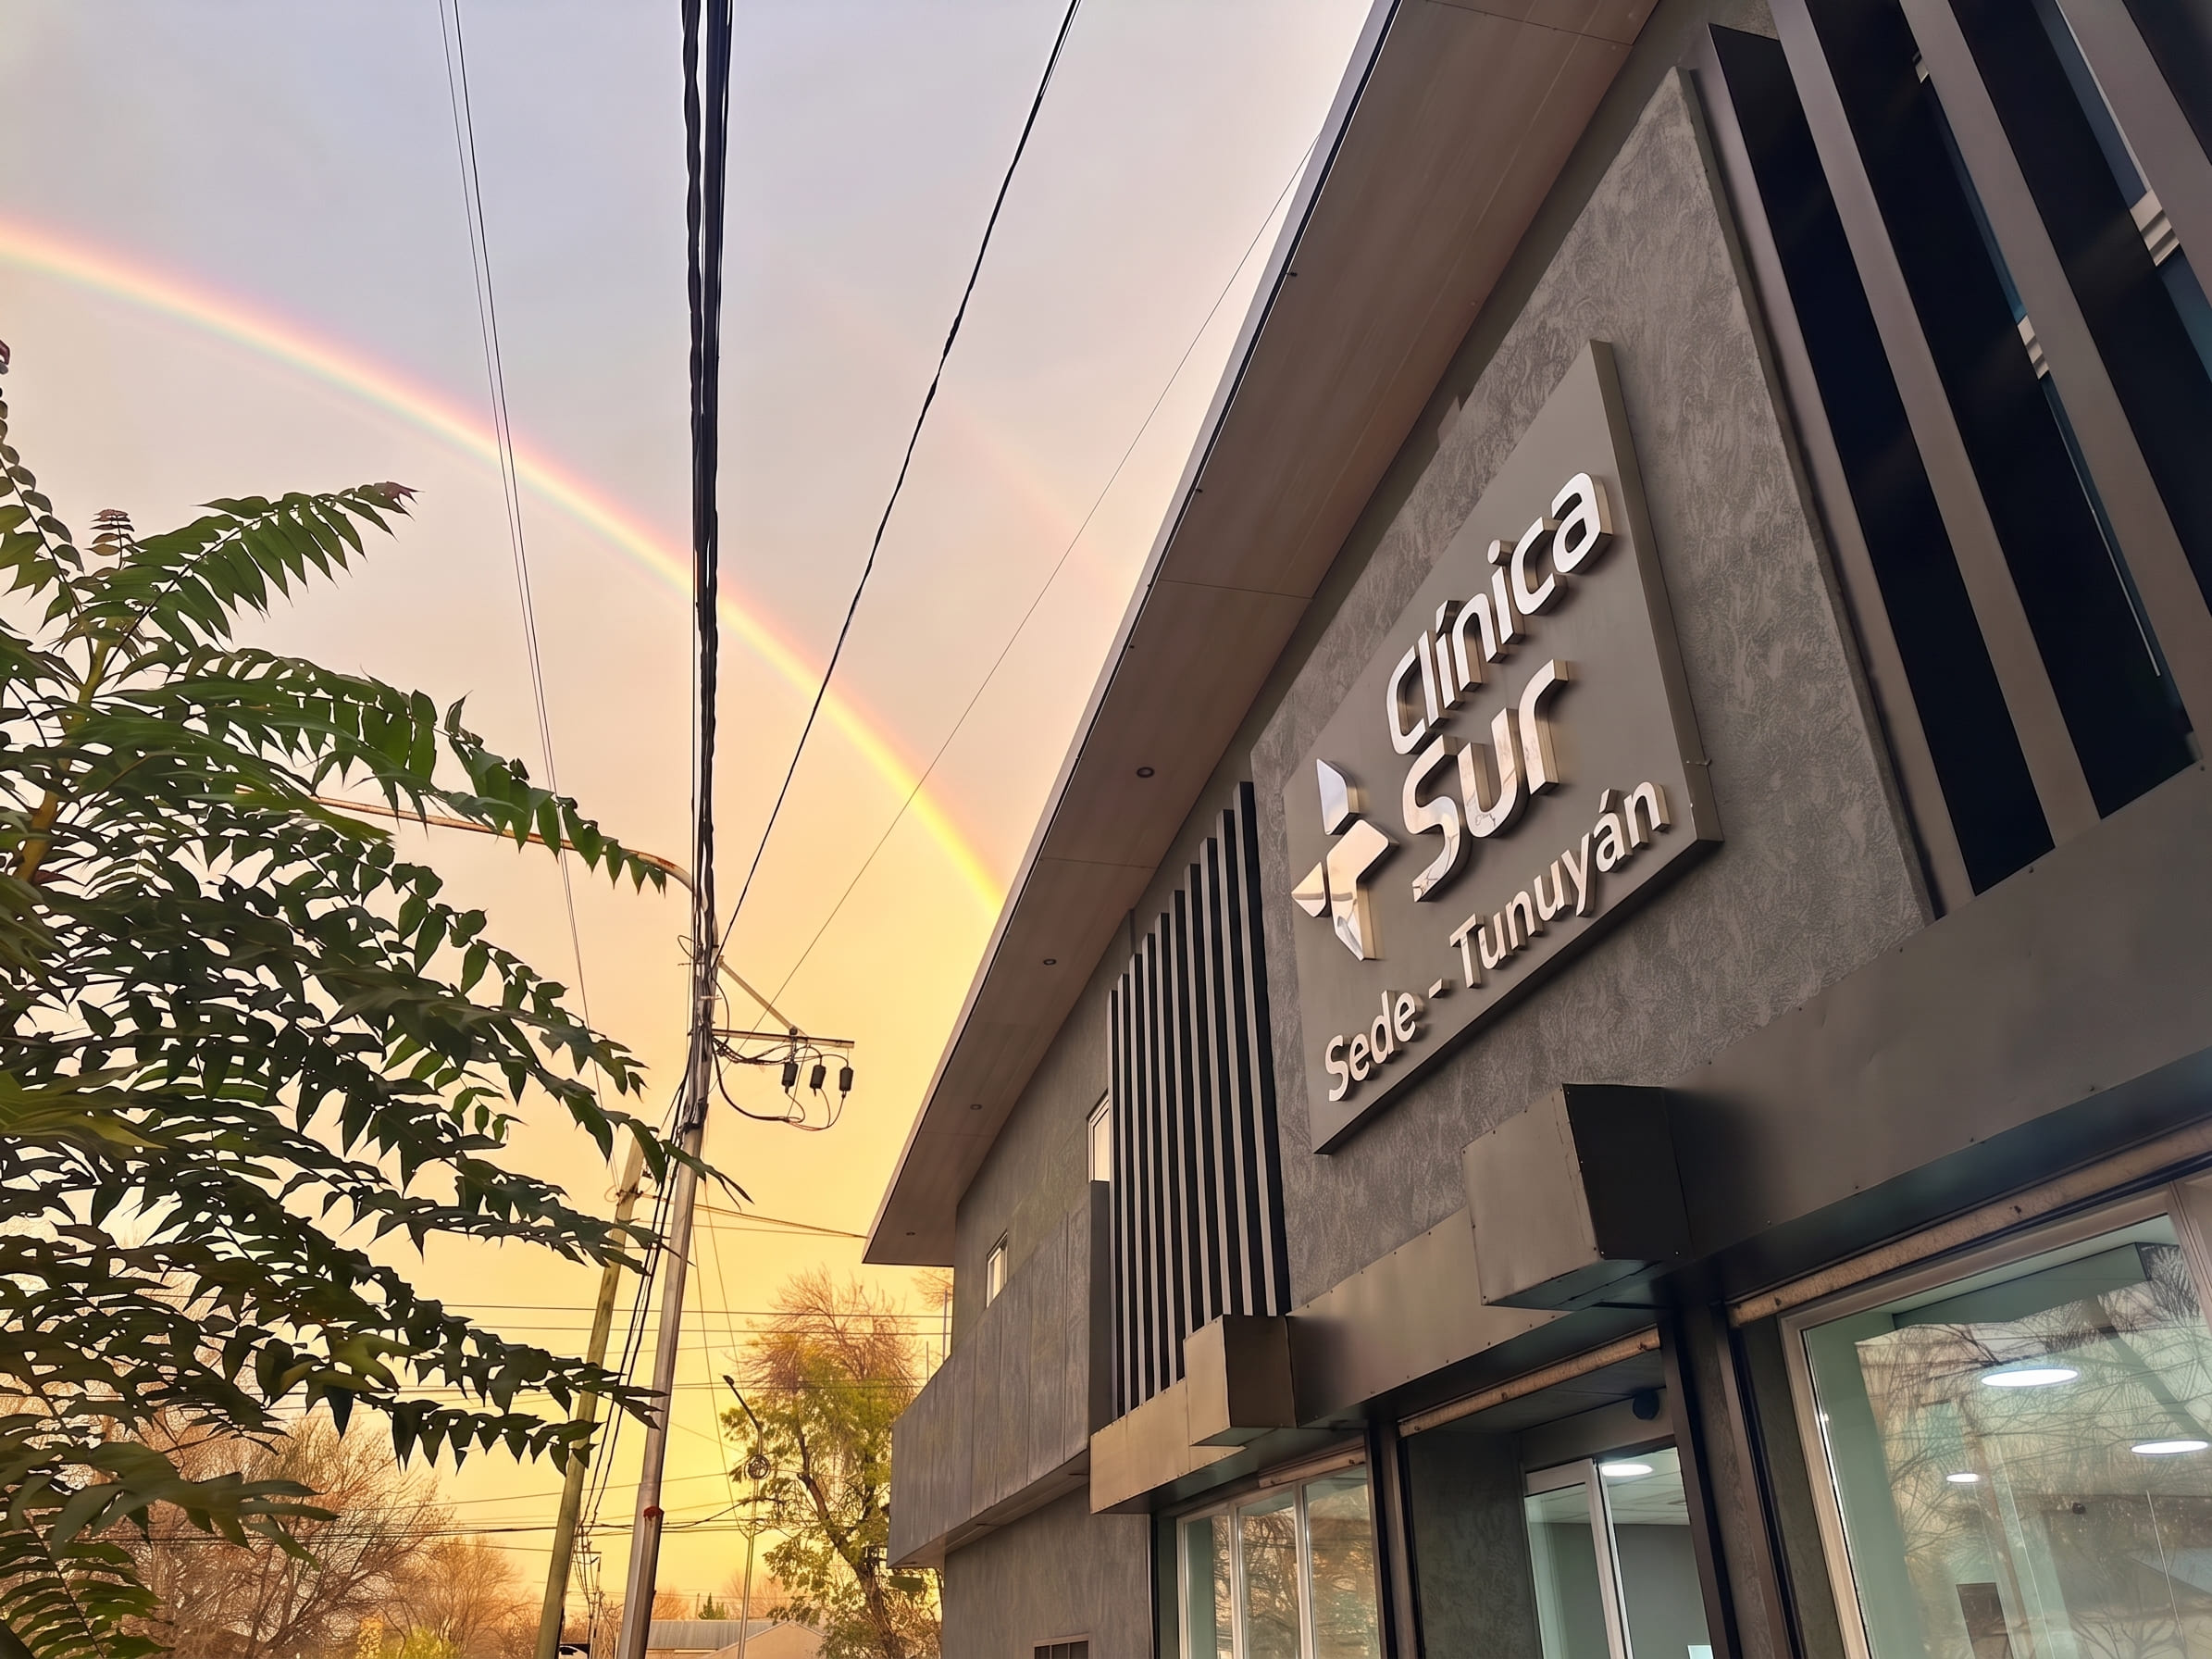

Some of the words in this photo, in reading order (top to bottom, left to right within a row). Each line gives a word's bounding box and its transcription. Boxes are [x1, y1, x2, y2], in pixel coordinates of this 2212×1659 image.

[1386, 471, 1613, 755] Clínica
[1402, 658, 1569, 903] Sur
[1325, 989, 1425, 1103] Sede
[1449, 780, 1671, 989] Tunuyán
